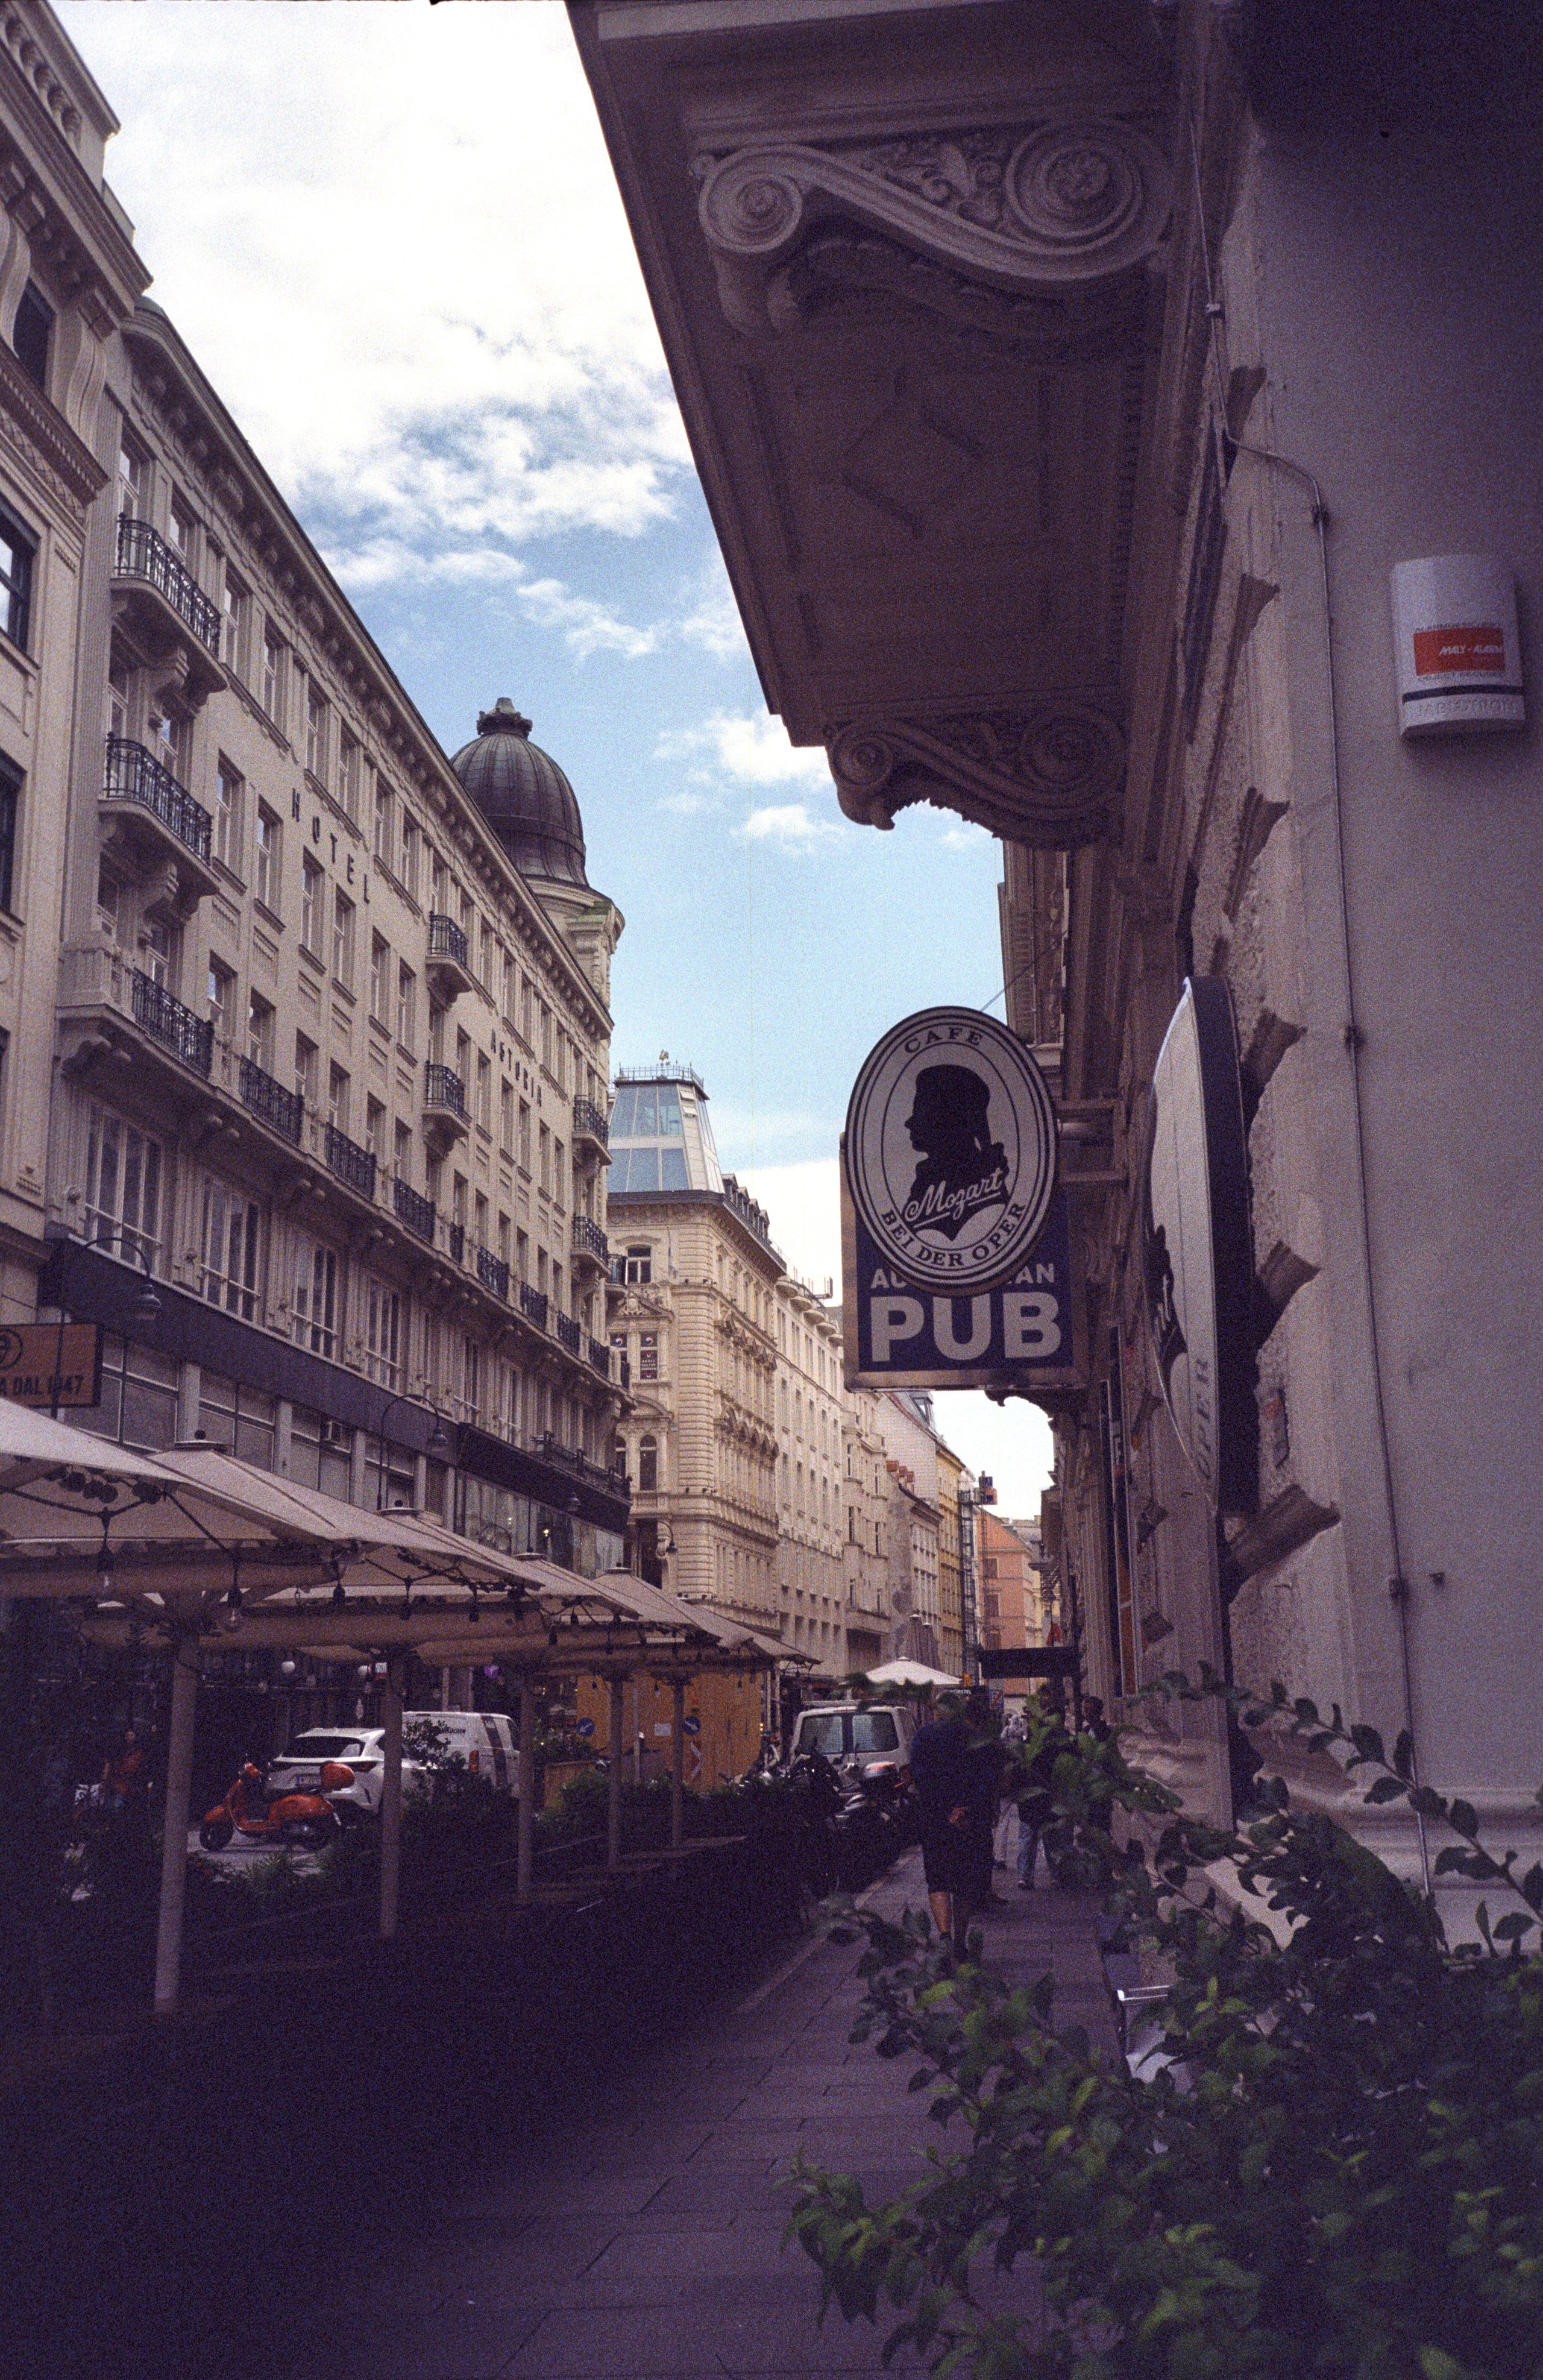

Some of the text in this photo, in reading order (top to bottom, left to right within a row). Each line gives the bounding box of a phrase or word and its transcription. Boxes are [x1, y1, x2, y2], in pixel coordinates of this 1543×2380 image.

[292, 787, 370, 904] HOTEL
[490, 1028, 542, 1107] ASTORIA
[904, 1027, 983, 1054] CAFE
[904, 1167, 1004, 1221] Mozart
[881, 1203, 1025, 1267] BEI DER OPER
[870, 1292, 1061, 1362] PUB
[13, 1376, 42, 1396] DAL
